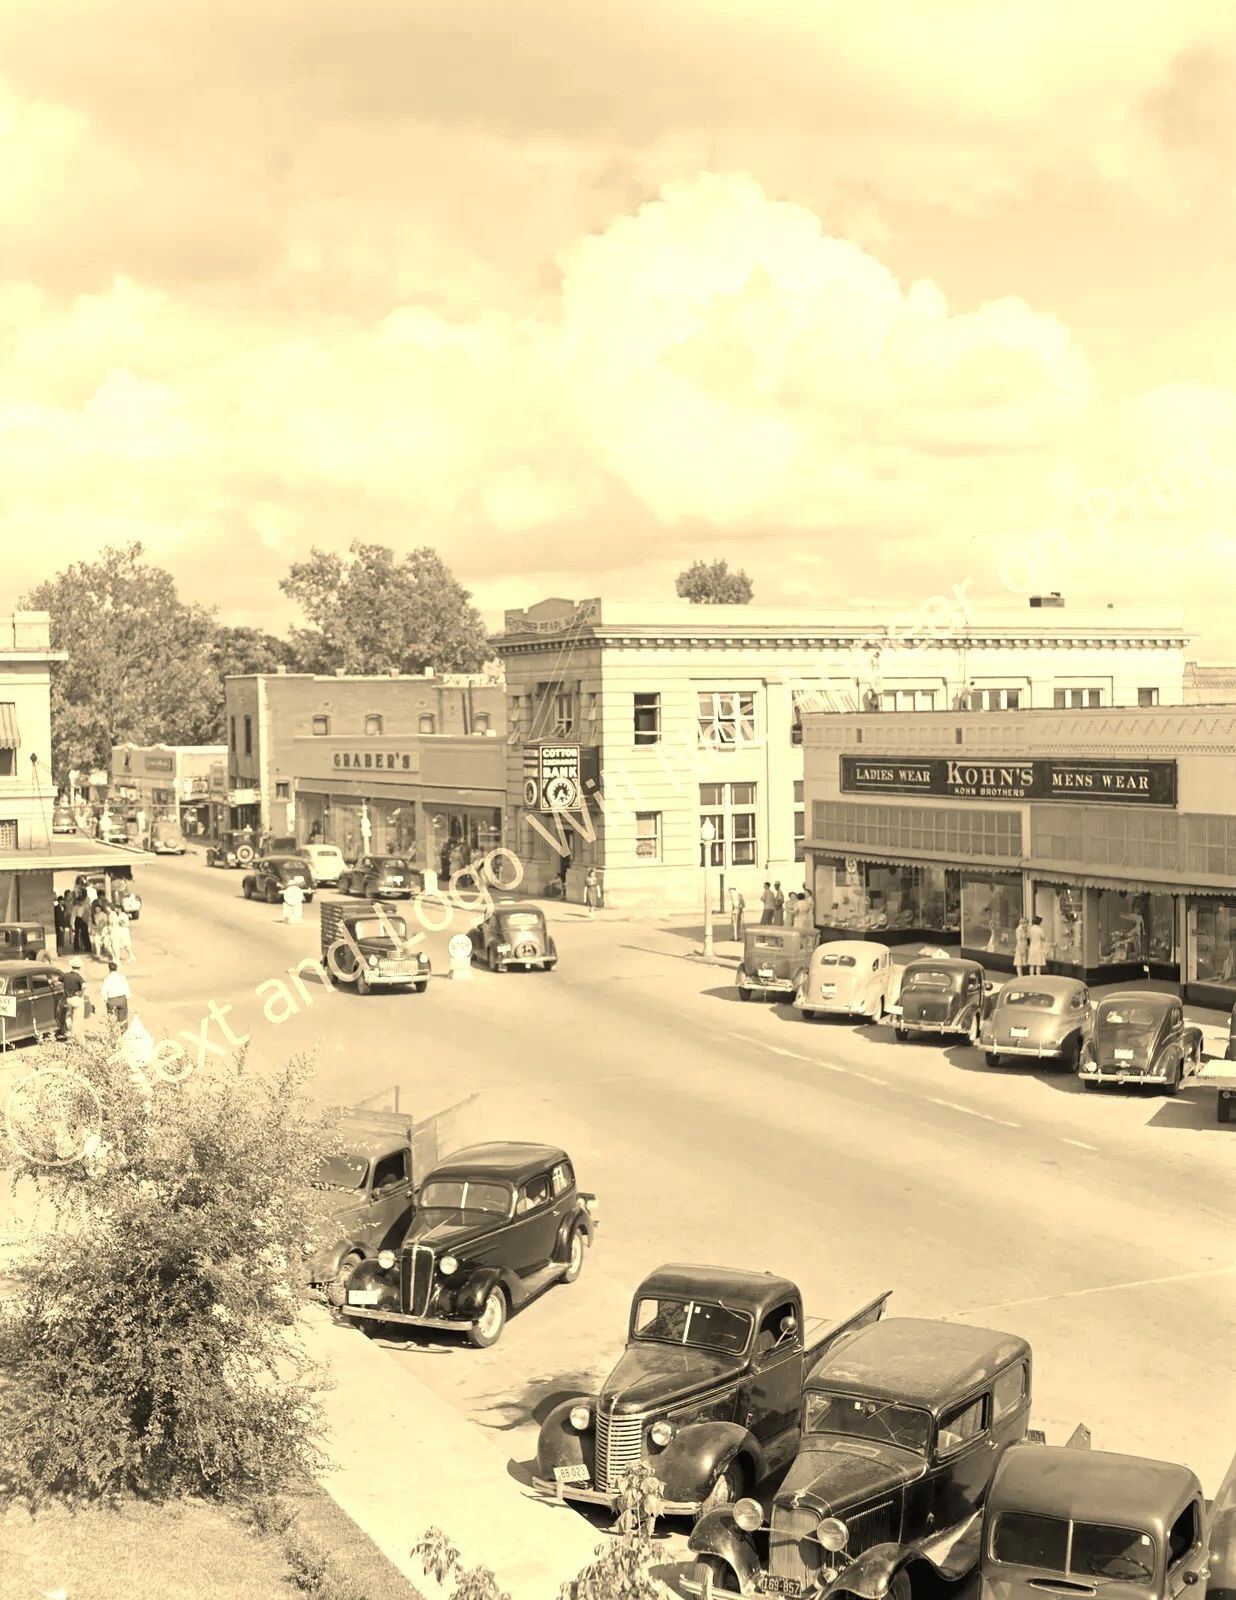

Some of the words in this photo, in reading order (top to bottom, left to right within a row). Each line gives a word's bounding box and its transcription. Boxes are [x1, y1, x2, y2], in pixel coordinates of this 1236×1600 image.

[333, 752, 411, 769] GRABER'S
[542, 748, 577, 758] COTTON
[542, 766, 577, 778] BANK
[855, 767, 894, 782] LADIES
[898, 769, 931, 783] WEAR
[945, 760, 1034, 787] KOHN'S
[1051, 772, 1093, 788] MENS
[1102, 773, 1149, 790] WEAR
[980, 787, 1025, 798] BROTHERS
